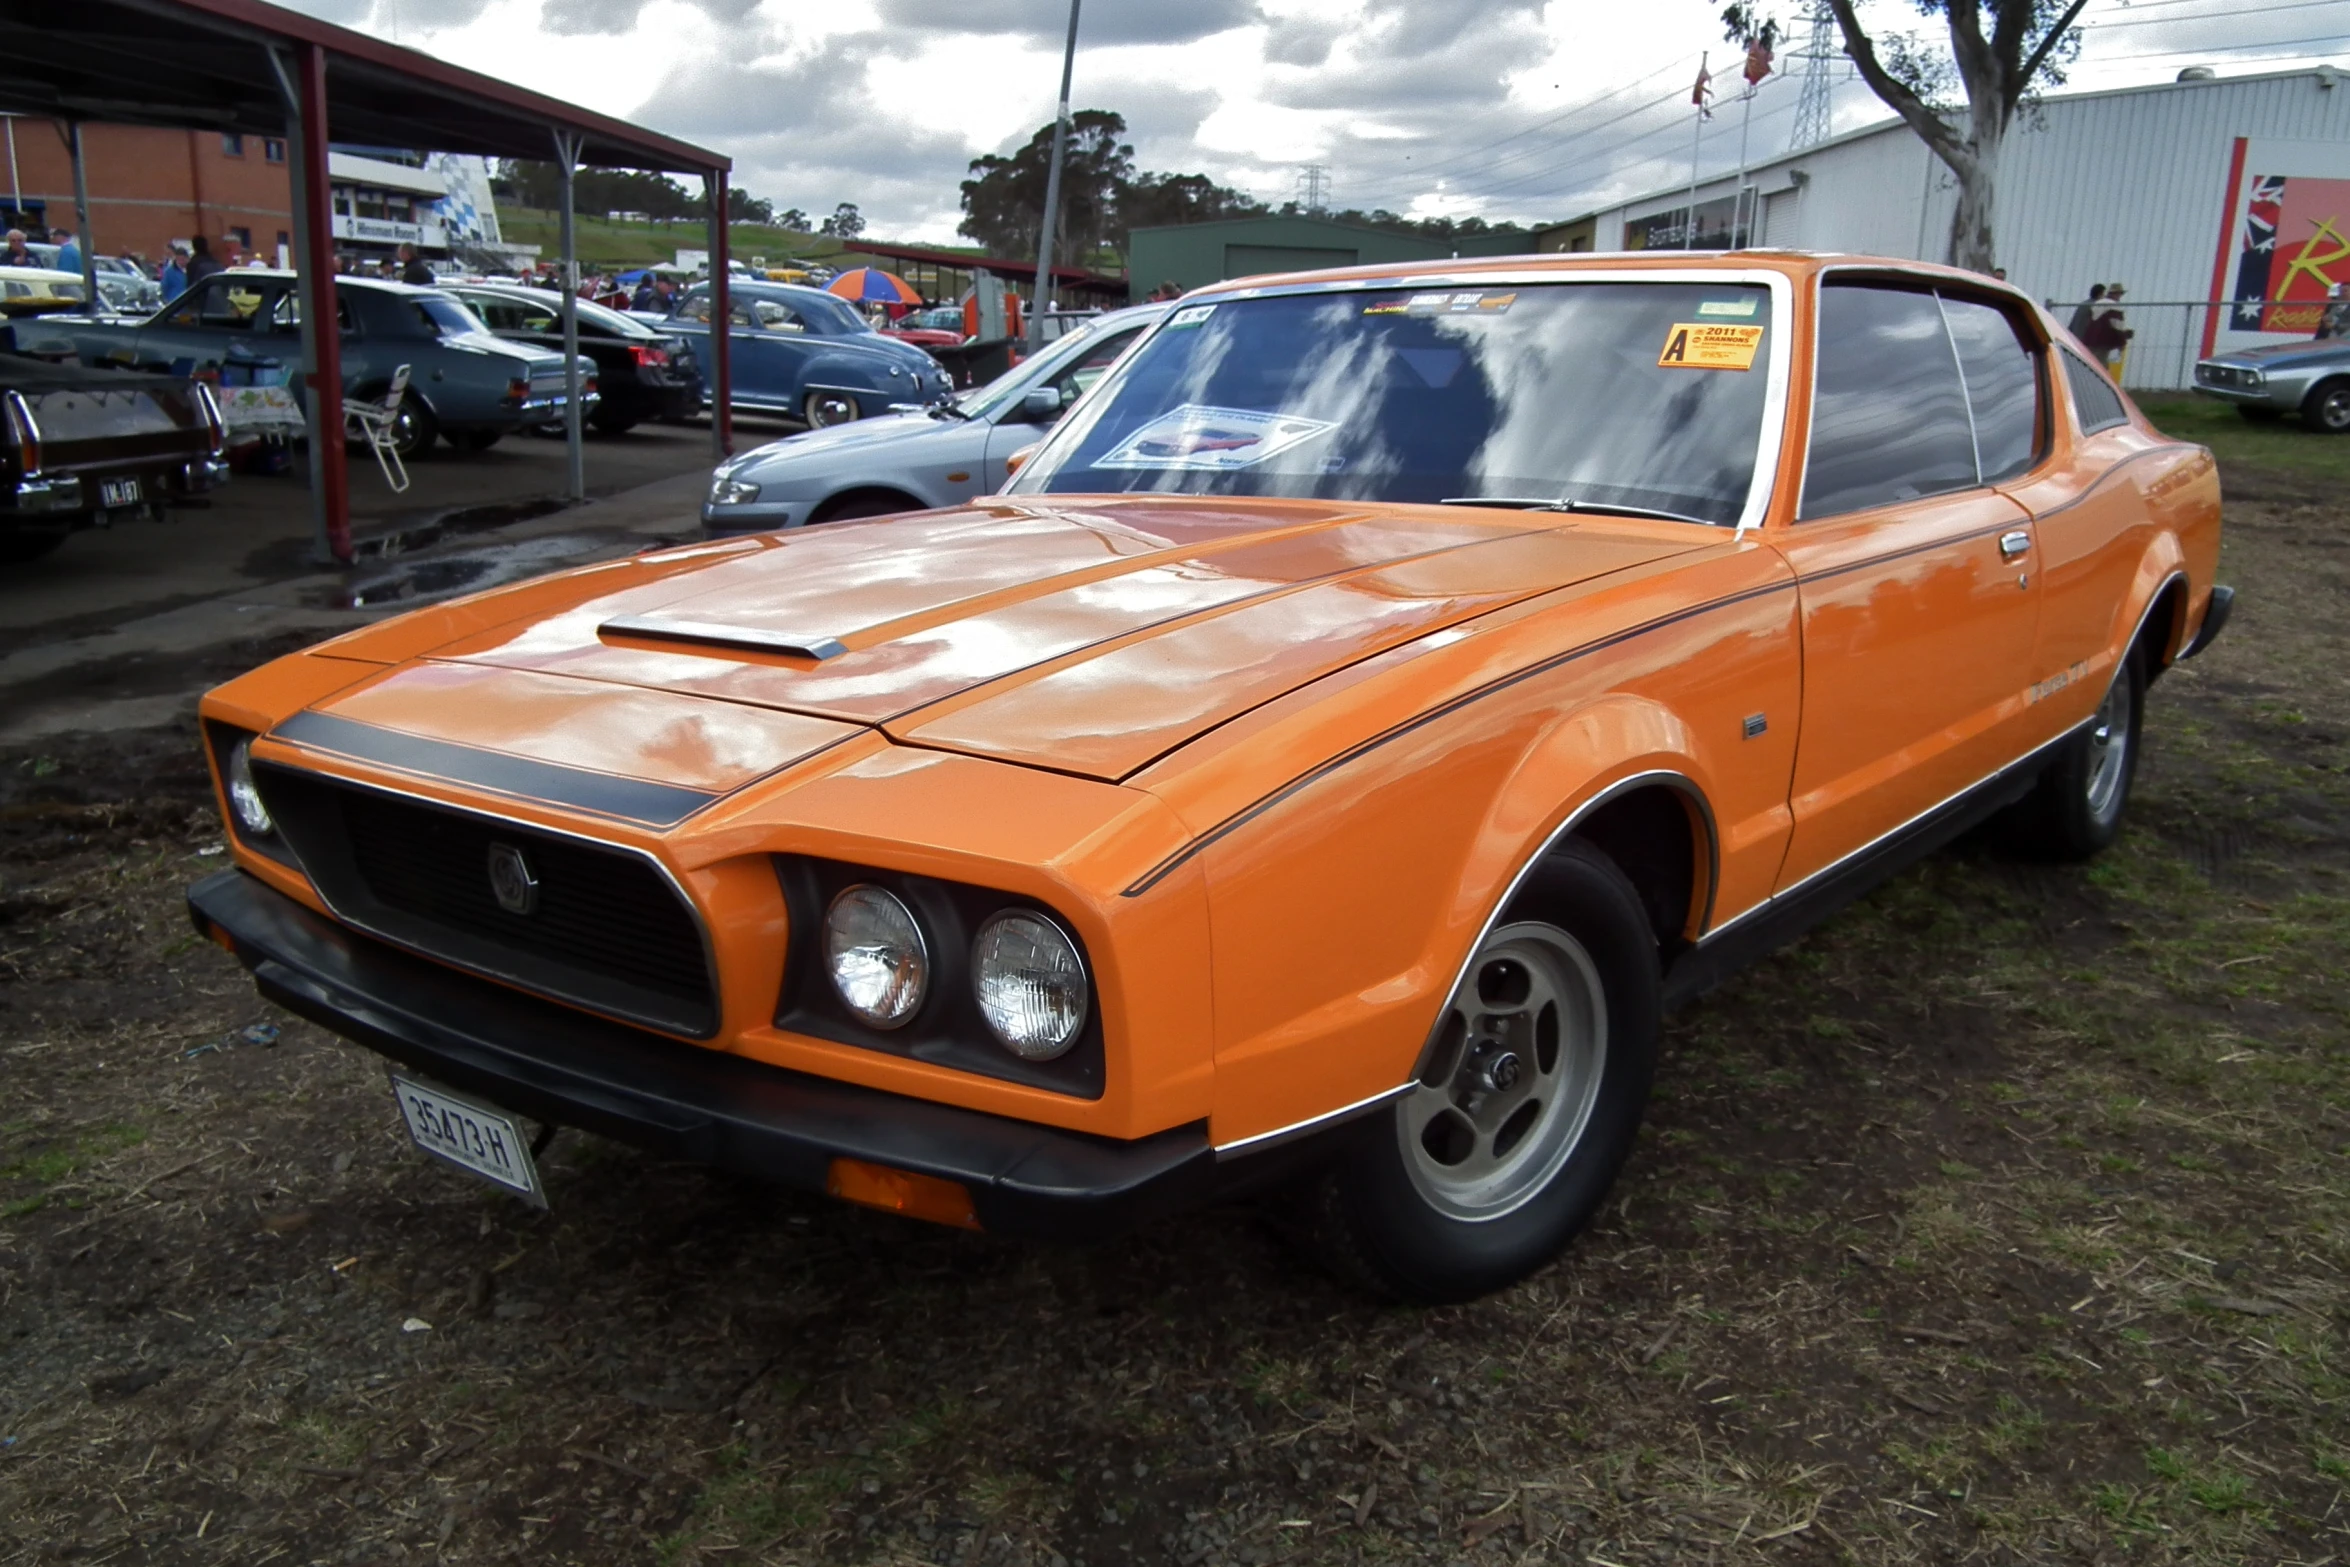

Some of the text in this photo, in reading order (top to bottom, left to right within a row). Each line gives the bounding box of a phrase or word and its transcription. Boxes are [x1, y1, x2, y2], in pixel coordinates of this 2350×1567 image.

[1706, 327, 1736, 336] 2011
[1703, 336, 1750, 344] SHANNONS
[1662, 329, 1689, 362] A
